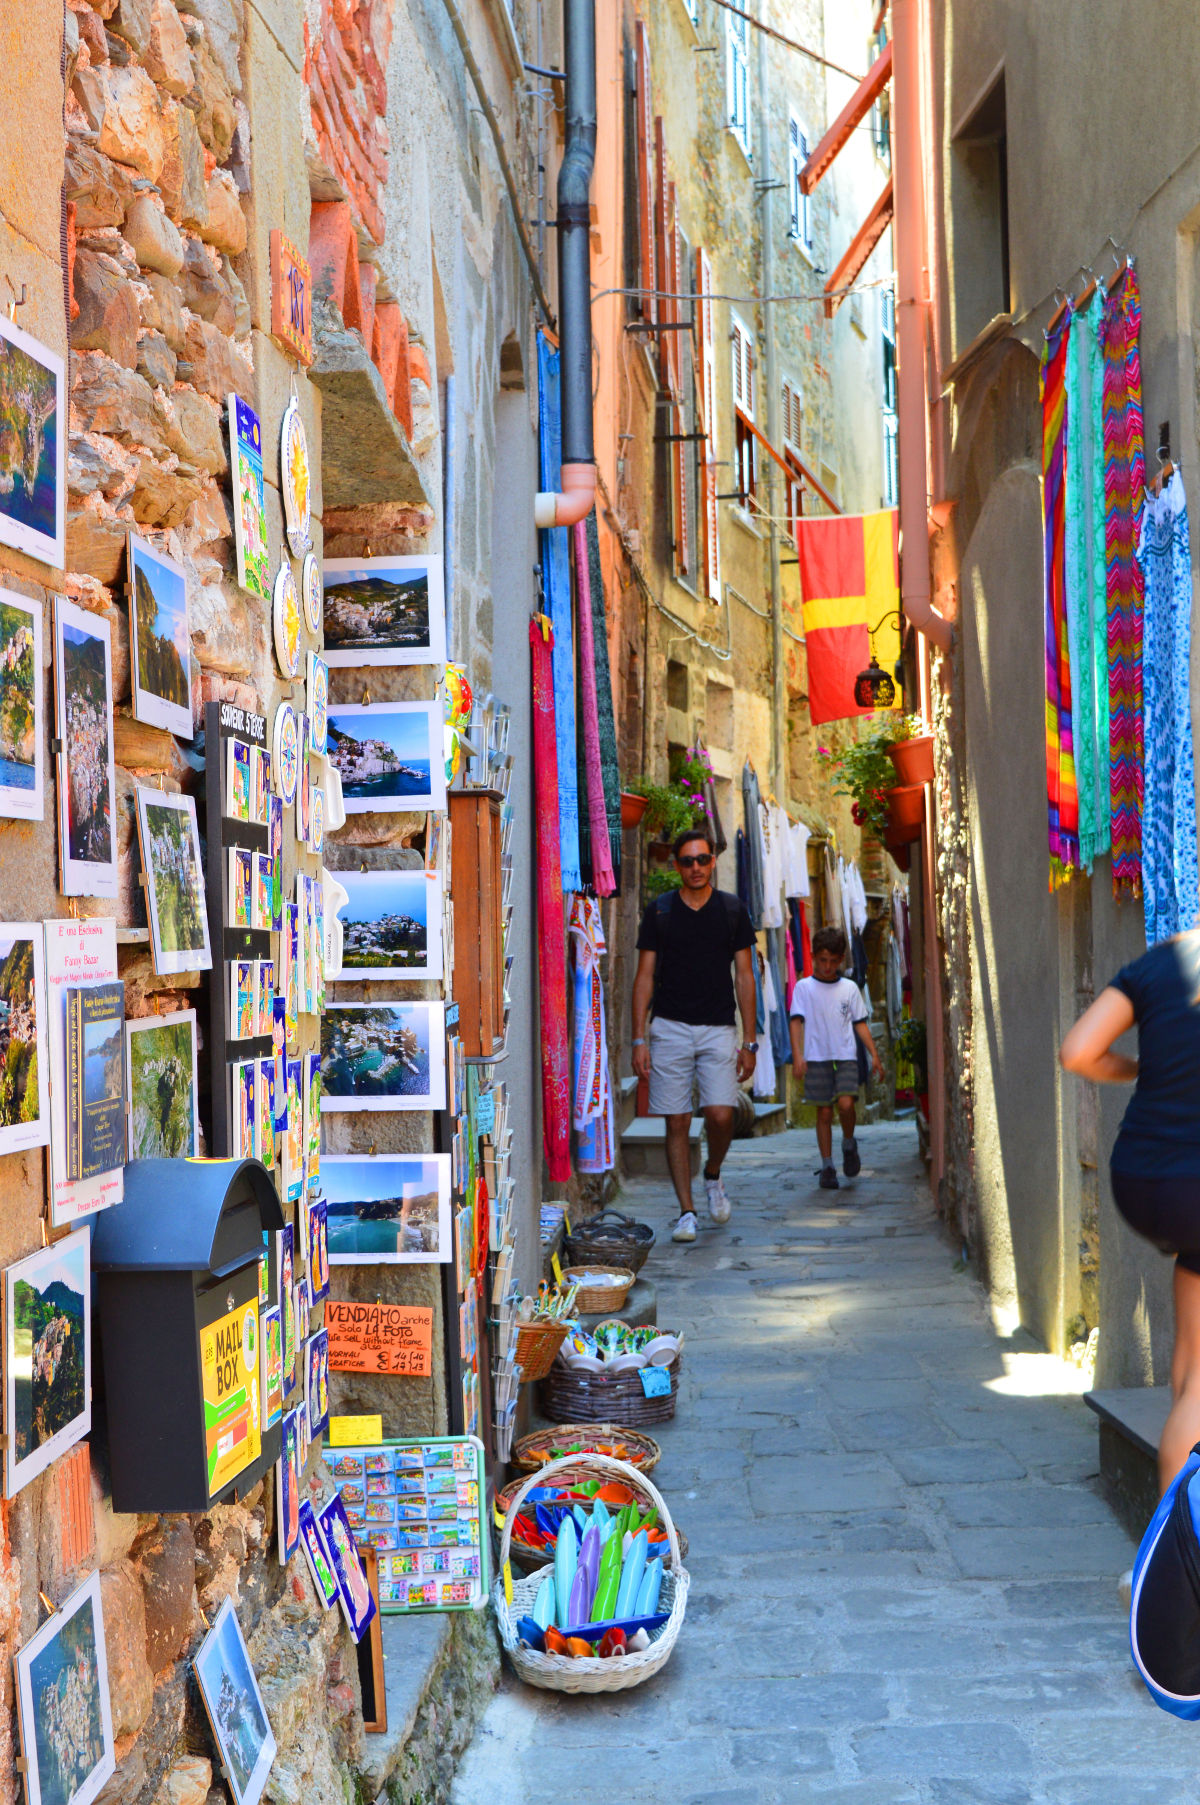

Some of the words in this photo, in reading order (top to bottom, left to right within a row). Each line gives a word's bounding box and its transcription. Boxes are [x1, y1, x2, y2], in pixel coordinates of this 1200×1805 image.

[288, 264, 305, 335] 187
[78, 924, 103, 936] Esclusiva
[64, 956, 82, 968] Fanny
[83, 954, 99, 966] Bazar
[329, 1304, 401, 1325] VENDIAMO
[400, 1314, 430, 1325] anche
[338, 1323, 362, 1333] Solo
[365, 1323, 379, 1337] LA
[382, 1325, 413, 1338] FOTO
[216, 1320, 243, 1364] MAIL
[328, 1333, 341, 1342] We
[363, 1335, 395, 1345] without
[398, 1336, 423, 1349] frame
[376, 1351, 389, 1362] €
[394, 1351, 407, 1359] 14
[413, 1353, 424, 1361] 10
[328, 1359, 366, 1367] GRAFICHE
[376, 1361, 389, 1371] €
[391, 1361, 406, 1371] 17
[412, 1363, 424, 1371] 13
[217, 1354, 239, 1397] BOX
